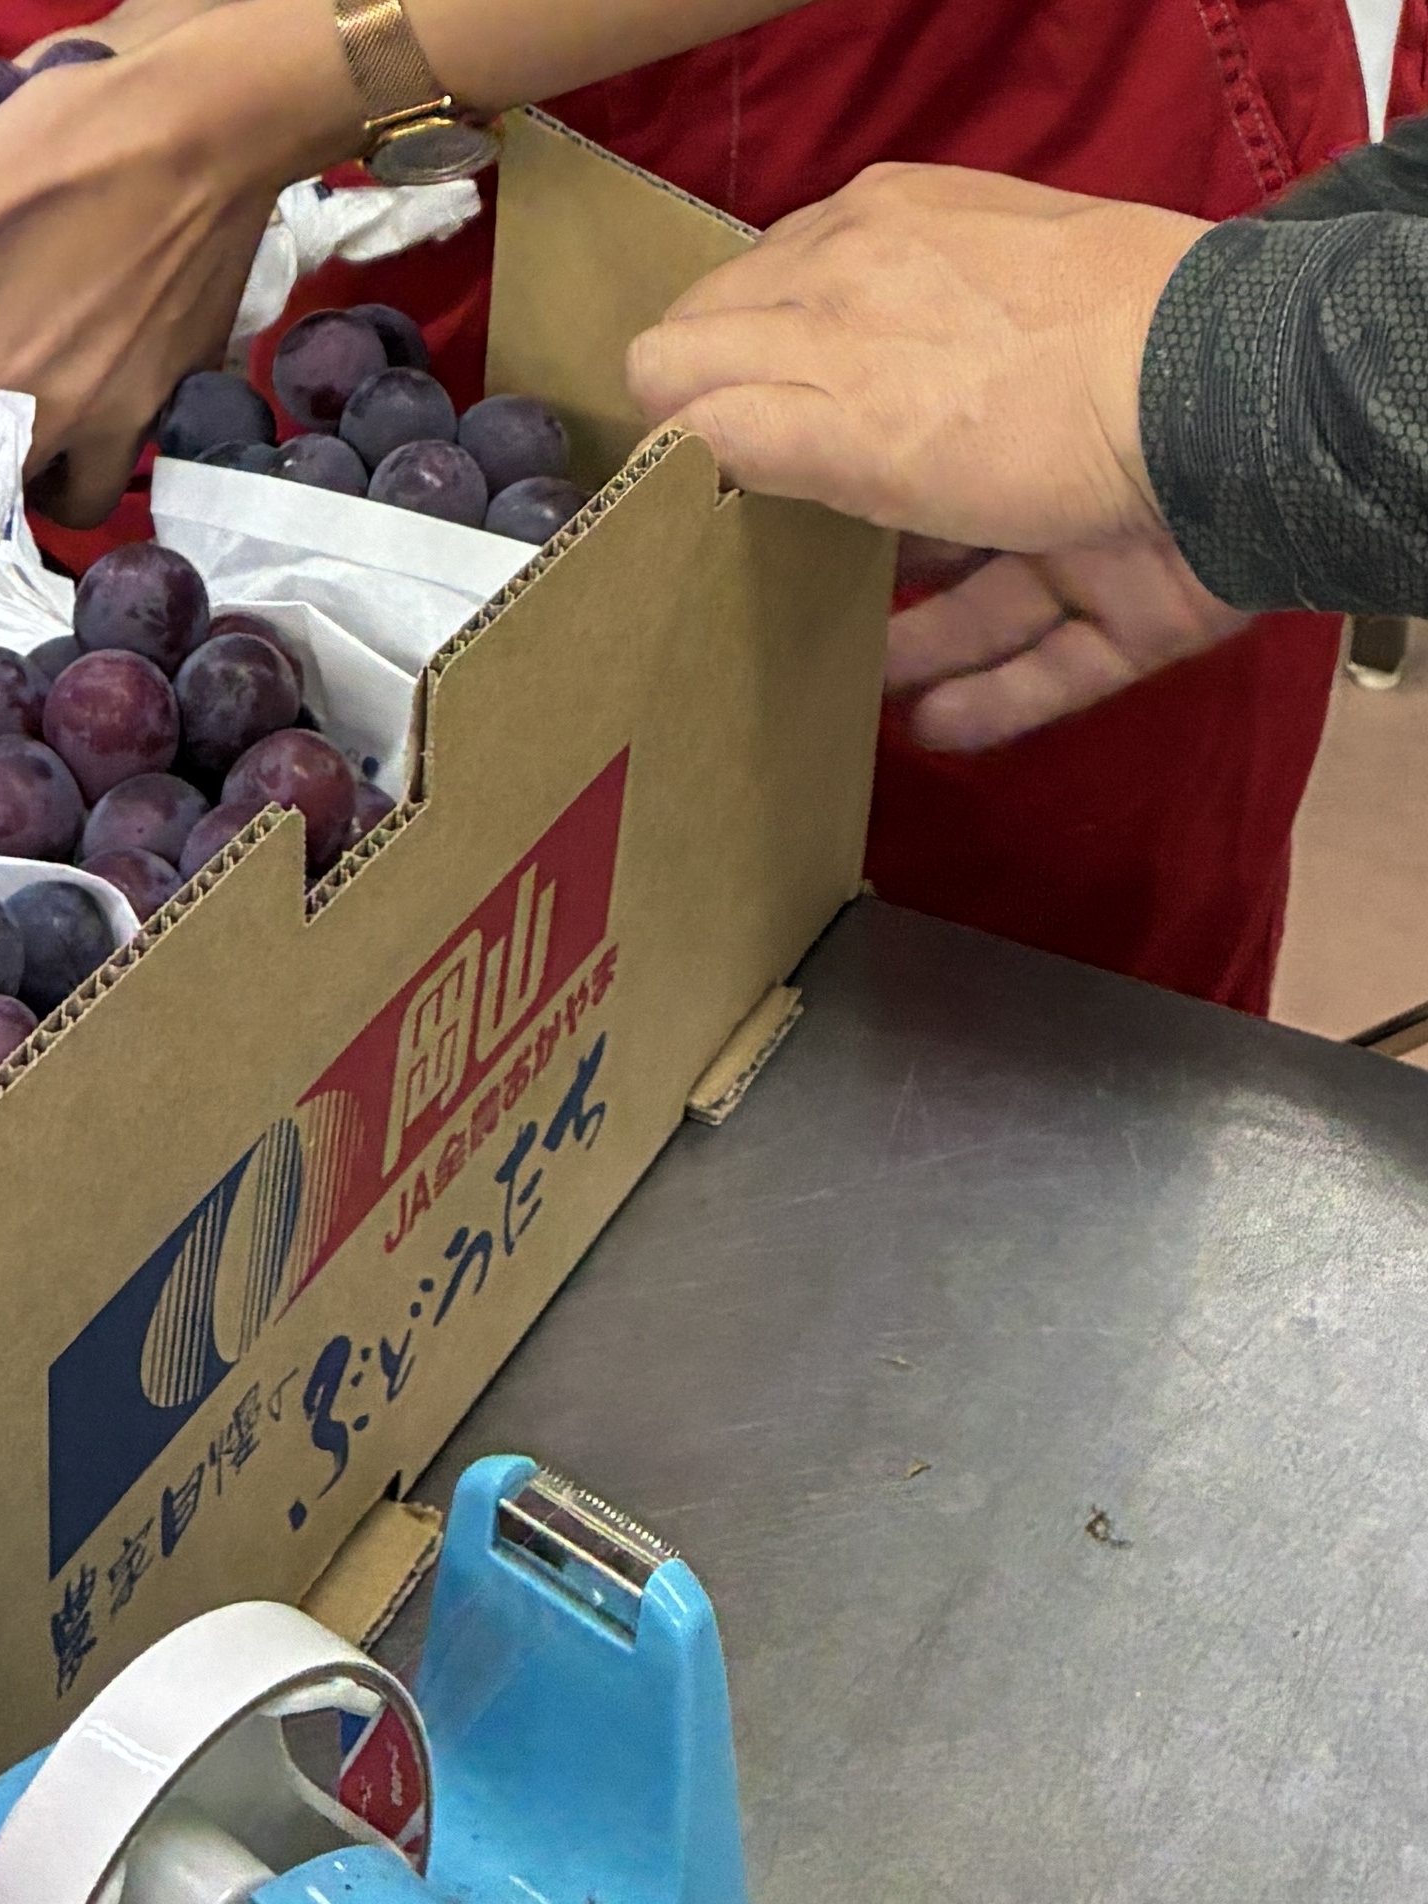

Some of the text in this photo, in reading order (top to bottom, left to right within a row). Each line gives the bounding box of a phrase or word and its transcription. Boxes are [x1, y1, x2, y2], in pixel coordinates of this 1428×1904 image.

[382, 862, 557, 1179] 岡山
[383, 942, 619, 1254] JA全農おかやま
